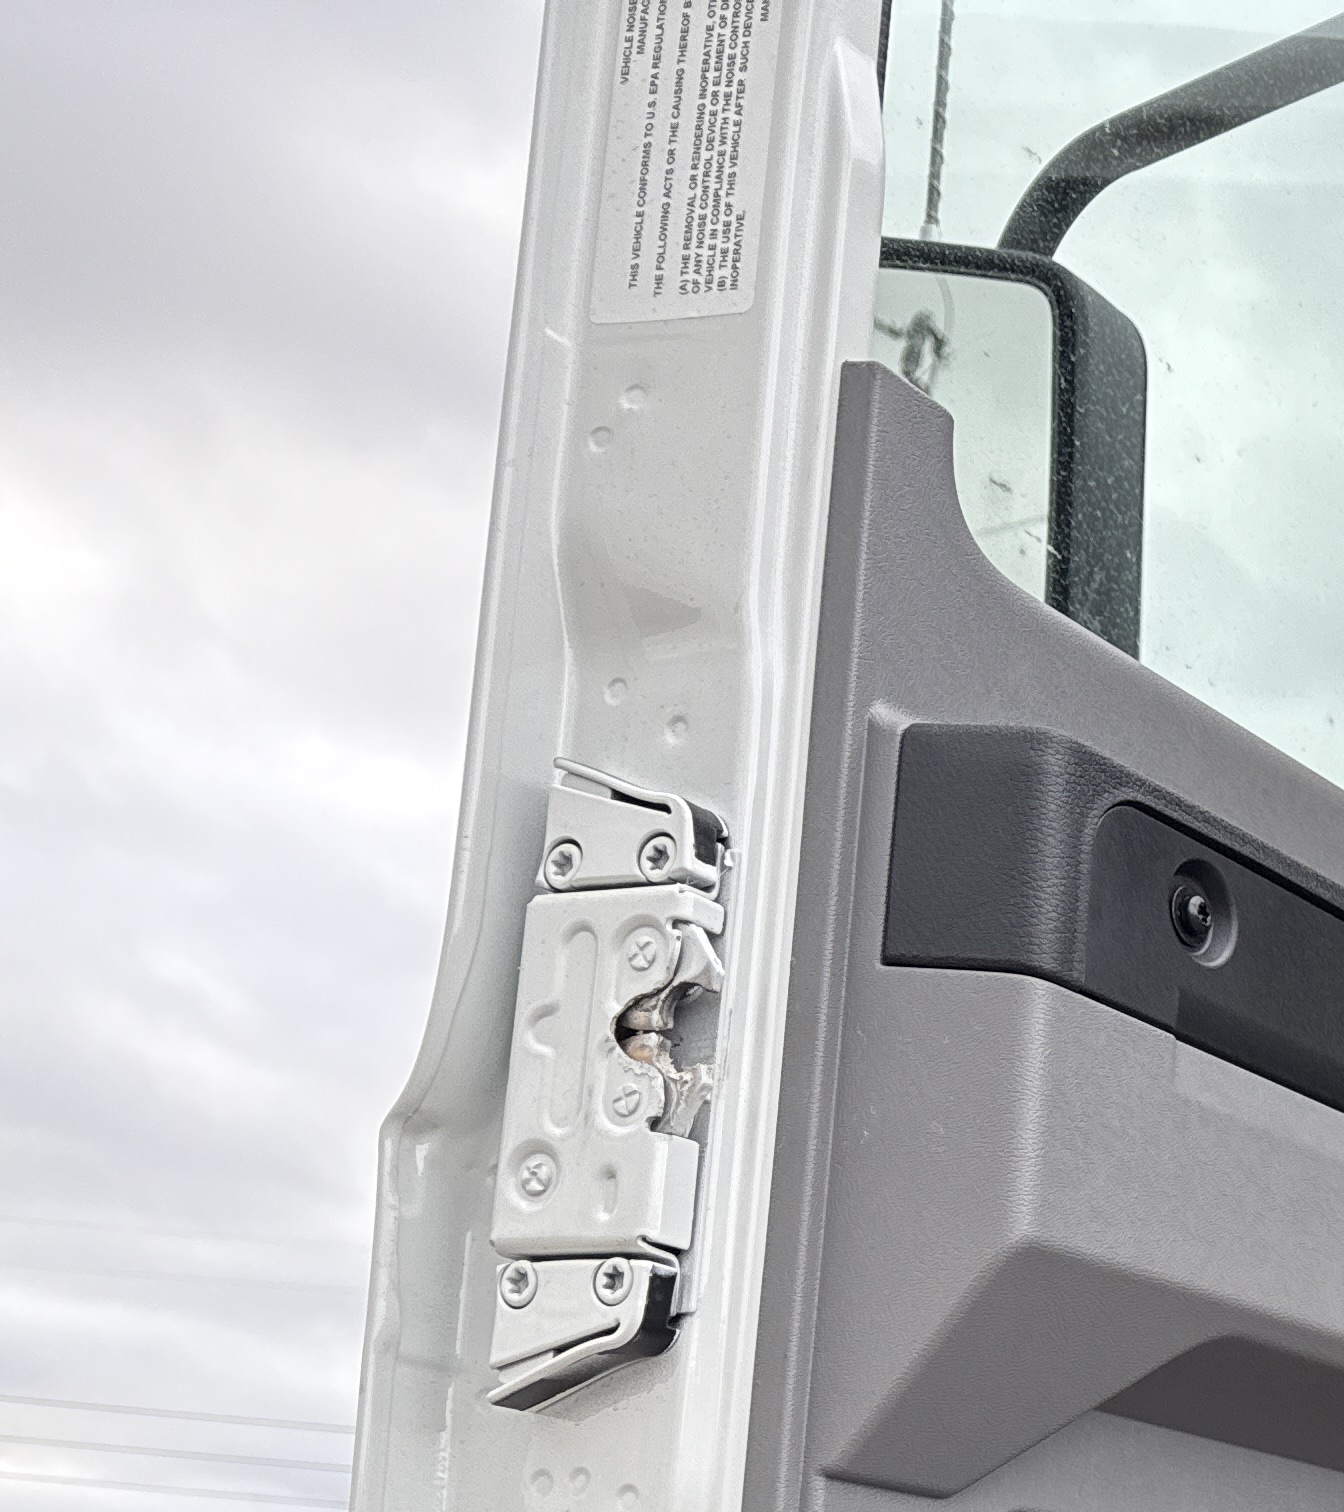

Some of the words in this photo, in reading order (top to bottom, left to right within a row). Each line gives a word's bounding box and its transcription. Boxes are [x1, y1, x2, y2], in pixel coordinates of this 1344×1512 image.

[717, 14, 728, 28] OF
[676, 11, 691, 64] THEREOF
[619, 35, 633, 84] VEHICLE
[712, 32, 726, 86] ELEMENT
[738, 40, 750, 72] SUCH
[648, 71, 659, 94] EPA
[724, 52, 736, 87] NOISE
[670, 67, 685, 119] CAUSING
[710, 89, 720, 106] OR
[721, 90, 732, 113] THE
[646, 97, 657, 119] U.S.
[643, 122, 654, 138] TO
[668, 121, 679, 144] THE
[690, 102, 706, 170] RENDERING
[705, 108, 718, 151] DEVICE
[718, 116, 729, 146] WITH
[728, 118, 742, 167] VEHICLE
[666, 148, 676, 164] OR
[636, 141, 652, 207] CONFORMS
[662, 167, 674, 199] ACTS
[688, 173, 699, 190] OR
[699, 154, 713, 209] CONTROL
[710, 149, 726, 225] COMPLIANCE
[725, 171, 736, 197] THIS
[682, 192, 697, 250] REMOVAL
[723, 200, 734, 216] OF
[631, 210, 644, 260] VEHICLE
[655, 201, 671, 270] FOLLOWING
[695, 212, 707, 248] NOISE
[708, 228, 718, 239] IN
[721, 219, 732, 243] USE
[679, 253, 690, 276] THE
[692, 251, 704, 275] ANY
[703, 242, 717, 292] VEHICLE
[718, 246, 729, 269] THE
[628, 262, 639, 288] THIS
[652, 273, 664, 297] THE
[678, 278, 690, 295] (A)
[690, 278, 701, 294] OF
[716, 275, 728, 291] (B)
